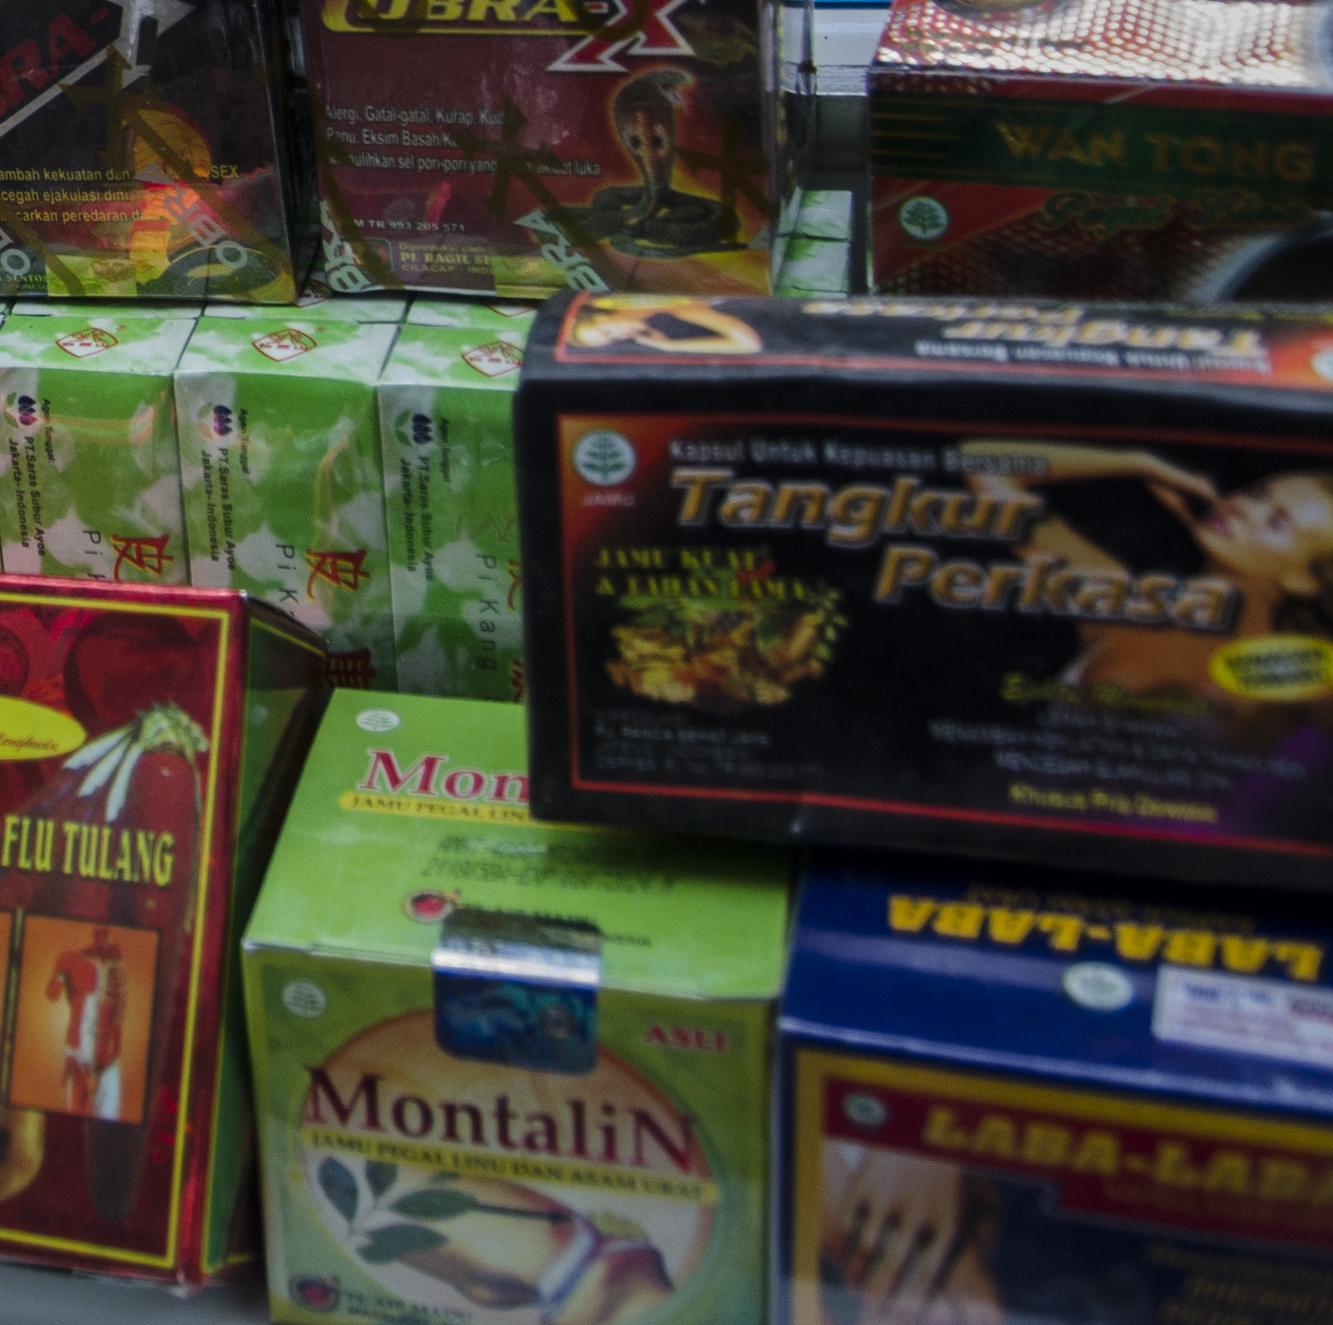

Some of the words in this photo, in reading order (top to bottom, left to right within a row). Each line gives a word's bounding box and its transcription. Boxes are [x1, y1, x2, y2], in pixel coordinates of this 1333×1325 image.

[996, 123, 1128, 168] WAN
[1144, 131, 1318, 184] TONG
[42, 187, 100, 206] ejakulasi
[102, 187, 130, 203] dini
[62, 207, 127, 225] peredaran
[667, 466, 1049, 549] Tangkur
[872, 544, 1239, 627] Perkasa
[59, 820, 176, 888] TULANG
[887, 892, 1329, 985] LABA-LABA
[645, 1024, 730, 1054] ASLI
[304, 1067, 701, 1173] MontaliN
